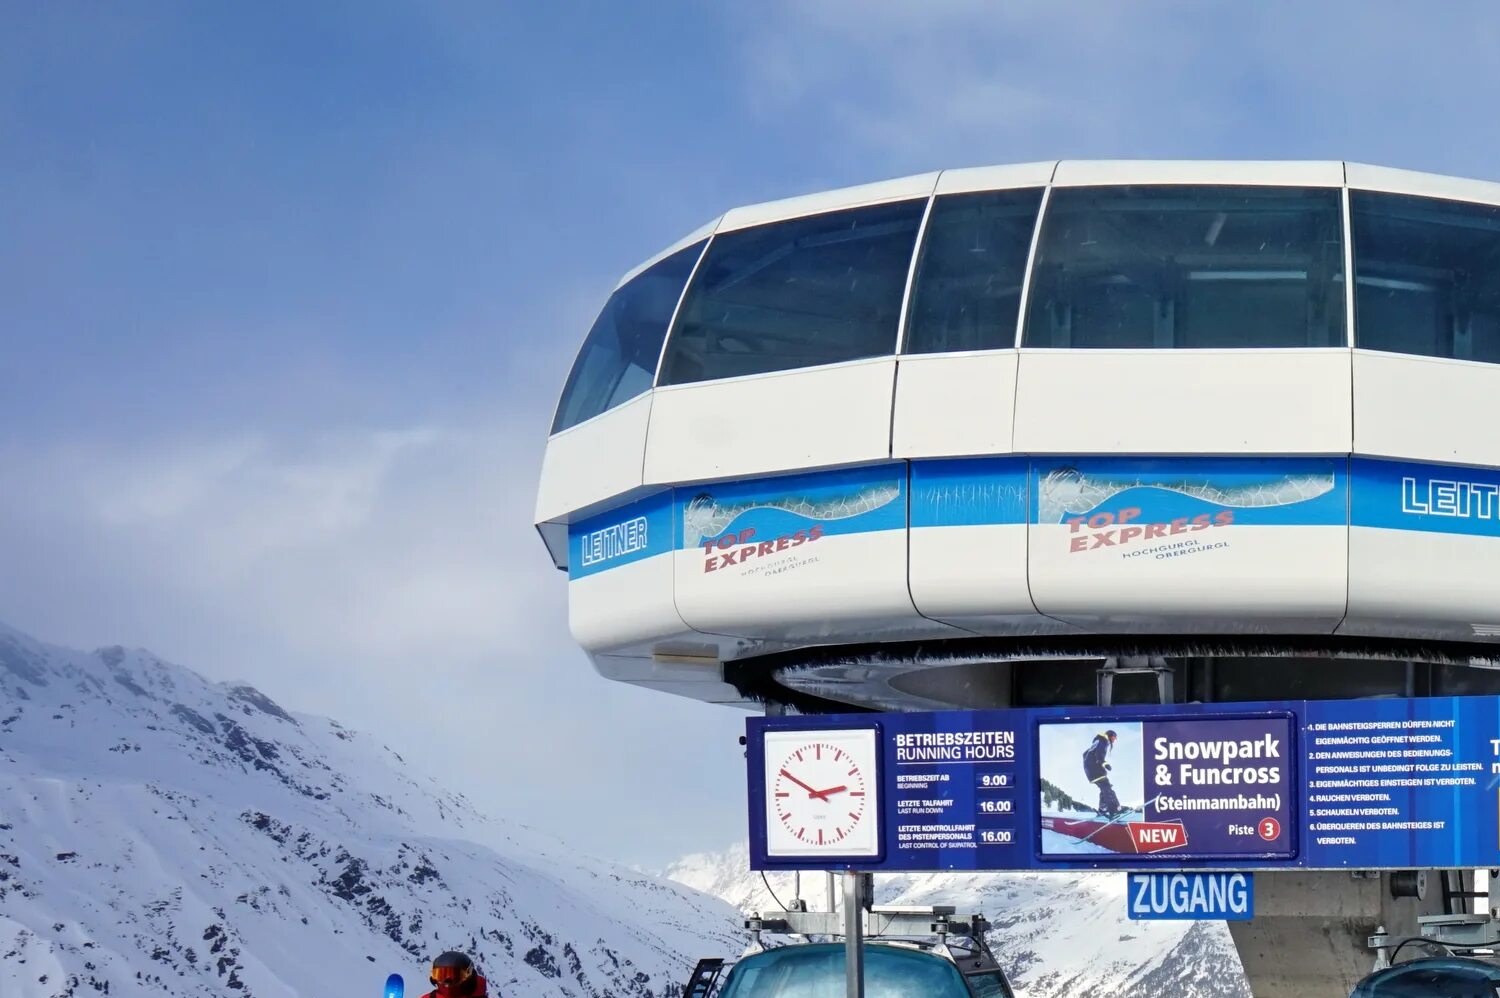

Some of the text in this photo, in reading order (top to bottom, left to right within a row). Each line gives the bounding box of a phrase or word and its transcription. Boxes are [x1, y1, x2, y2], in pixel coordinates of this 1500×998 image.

[1066, 506, 1142, 533] TOP
[1069, 510, 1235, 553] EXPRESS
[582, 516, 648, 567] LEITNER
[703, 528, 756, 555] TOP
[704, 524, 824, 573] EXPRESS
[1122, 538, 1201, 559] HOCHGURGL
[1155, 540, 1231, 560] OBERGURGL
[1328, 721, 1401, 731] BAHNSTEIGSPERREN
[1402, 719, 1432, 729] DÜRFEN
[1433, 720, 1456, 728] NICHT
[896, 731, 1015, 746] BETRIEBSZEITEN
[1315, 735, 1443, 745] EIGENMÄCHTIG GEÖFFNET WERDEN.
[896, 745, 1015, 761] RUNNING HOURS
[1154, 733, 1281, 764] Snowpark
[1309, 749, 1453, 760] 2. DEN ANWEISUNGEN DES BEDIENUNGS-
[1315, 763, 1484, 774] PERSONALS IST UNBEDINGT FOLGE ZU LEISTEN.
[896, 774, 950, 782] BETRIEBSZEIT AB
[982, 775, 1007, 786] 9.00
[1154, 764, 1281, 786] & Funcross
[1316, 779, 1380, 788] EIGENMÄCHTIGES
[1380, 778, 1423, 787] EINSTEIGEN
[1423, 778, 1435, 786] IST
[1435, 777, 1477, 786] VERBOTEN.
[1154, 793, 1281, 813] (Steinmannbahn)
[1350, 794, 1391, 802] VERBOTEN.
[980, 801, 1011, 812] 16.00
[1316, 808, 1360, 817] SCHAUKELN
[1360, 808, 1400, 816] VERBOTEN.
[922, 824, 976, 832] KONTROLLFAHRT
[1228, 823, 1274, 836] Piste 3
[1310, 821, 1445, 831] 6. ÜBERQUEREN DES BAHNSTEIGES IST
[912, 833, 973, 841] PISTENPERSONALS
[981, 831, 1011, 842] 16.00
[1139, 829, 1178, 843] NEW
[1316, 837, 1357, 845] VERBOTEN.
[1133, 873, 1248, 914] ZUGANG
